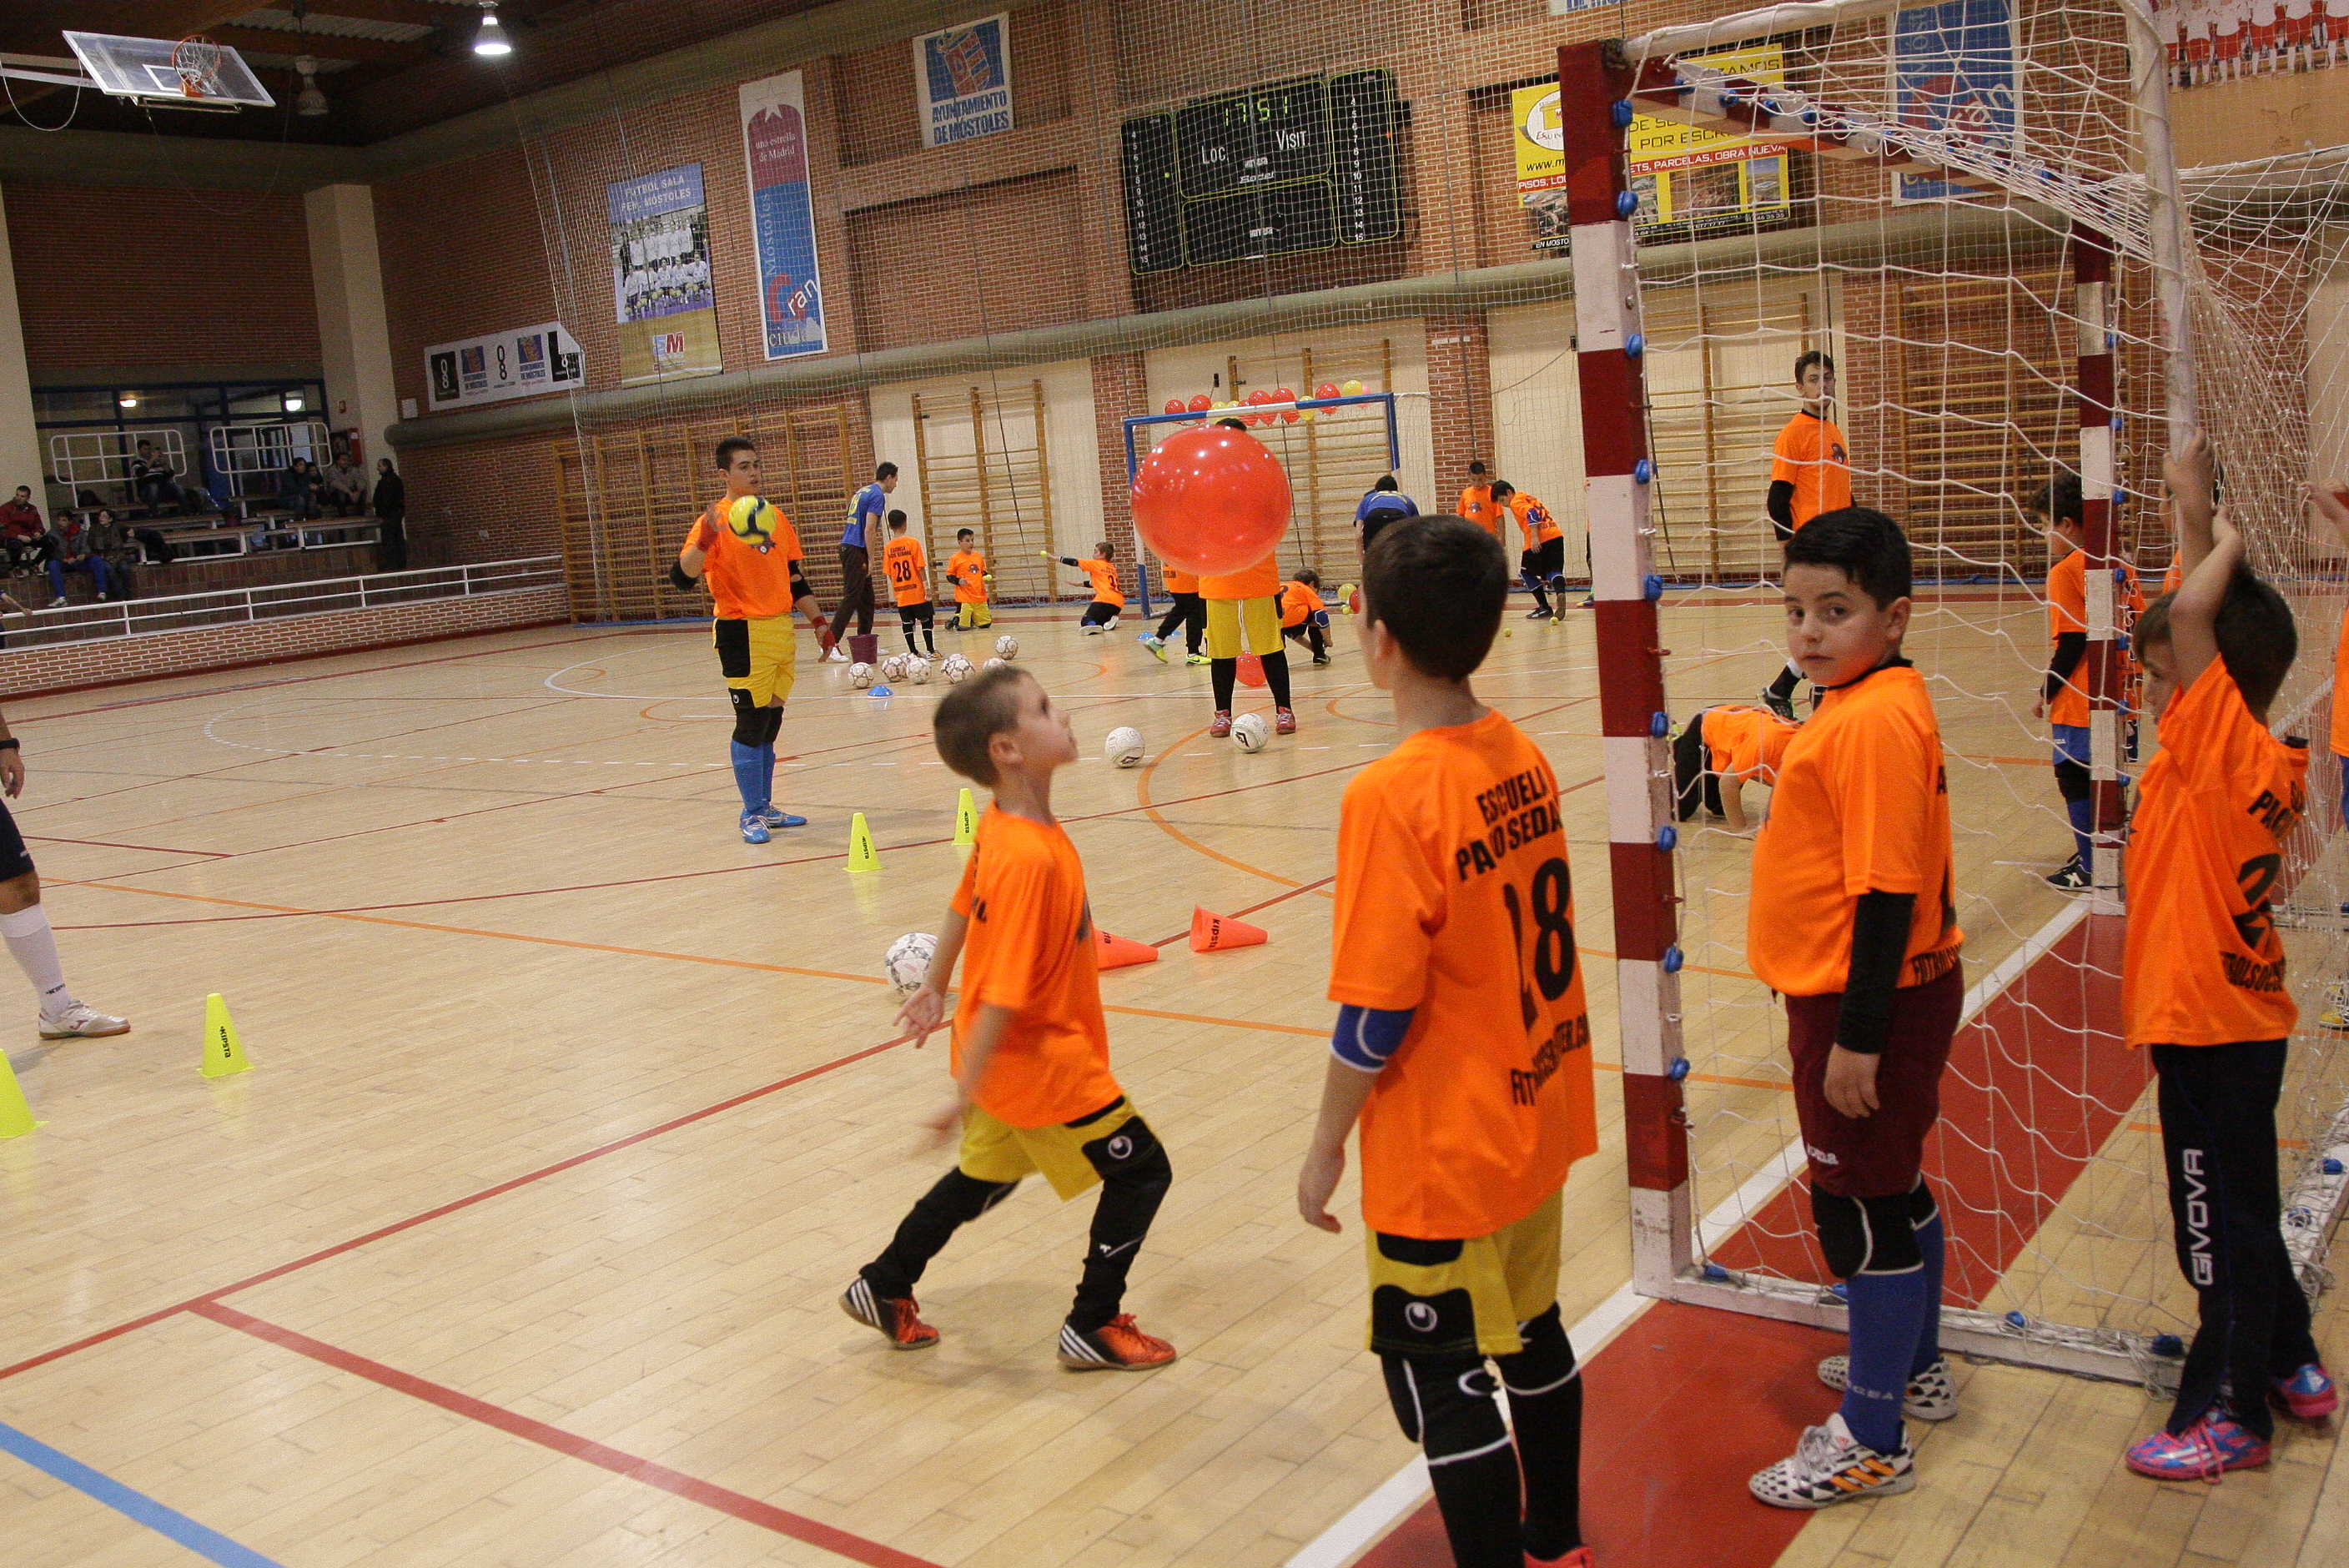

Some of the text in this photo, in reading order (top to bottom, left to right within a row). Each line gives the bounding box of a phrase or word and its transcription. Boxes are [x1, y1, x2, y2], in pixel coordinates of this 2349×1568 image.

[933, 90, 1007, 123] AYUNTAMIENTO
[755, 133, 796, 149] una estrella
[933, 125, 948, 144] DE
[1353, 135, 1358, 143] 7
[1640, 134, 1674, 149] POR
[759, 147, 796, 162] de Madrid
[1353, 172, 1361, 180] 10
[1518, 178, 1549, 190] PISOS,
[1654, 155, 1713, 168] PARCELAS,
[1715, 148, 1745, 161] OBRA
[661, 174, 684, 189] SALA
[1355, 197, 1363, 205] 12
[1355, 209, 1363, 217] 13
[893, 560, 912, 582] 28
[2182, 1148, 2213, 1285] GIVOVA
